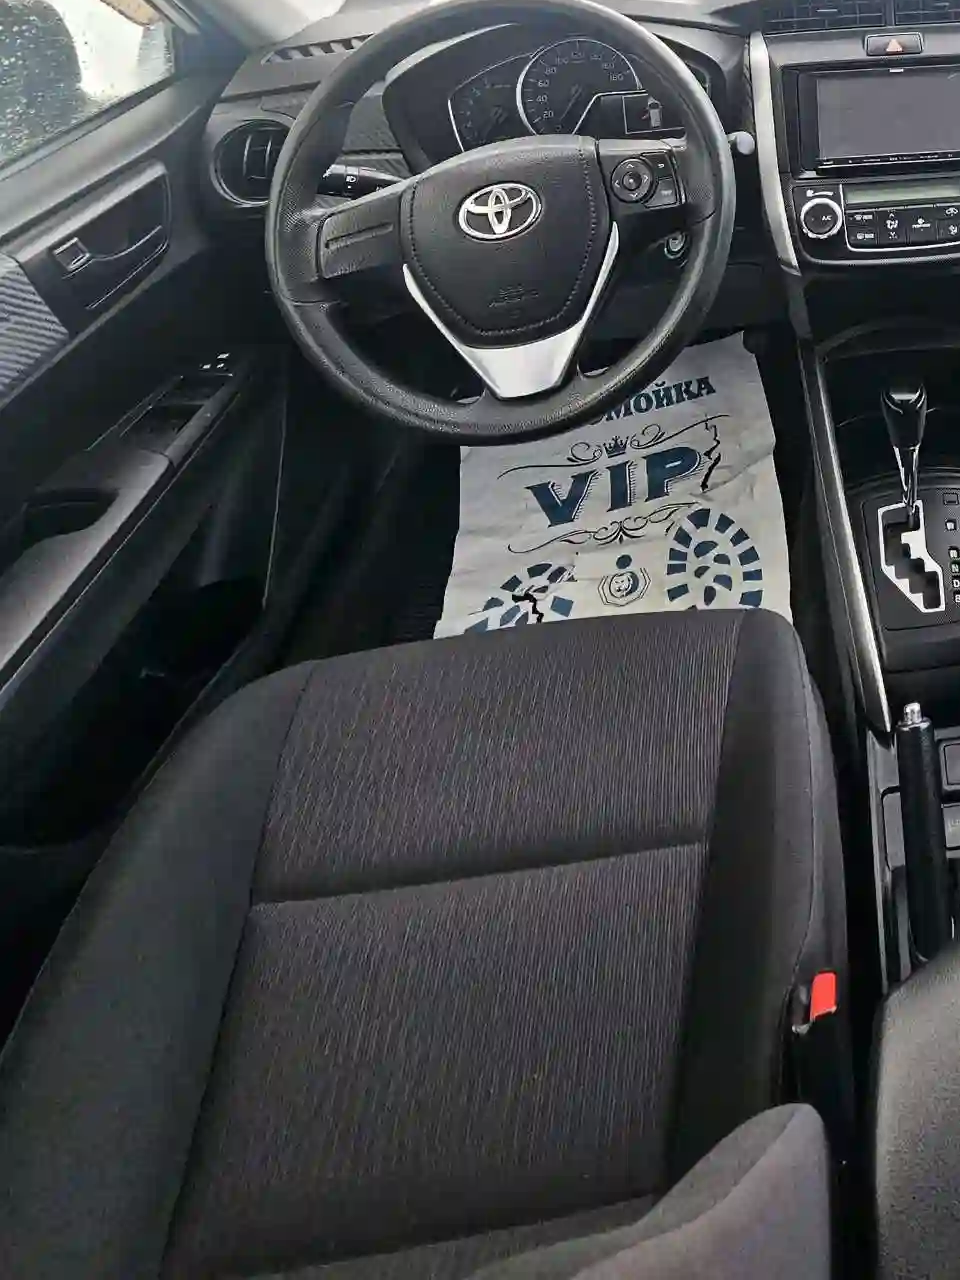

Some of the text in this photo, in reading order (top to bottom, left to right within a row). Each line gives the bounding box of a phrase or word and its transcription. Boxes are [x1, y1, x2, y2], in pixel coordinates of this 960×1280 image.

[543, 110, 553, 118] 20
[605, 376, 717, 422] МОЙКА
[525, 446, 708, 528] VIP
[953, 580, 960, 588] D
